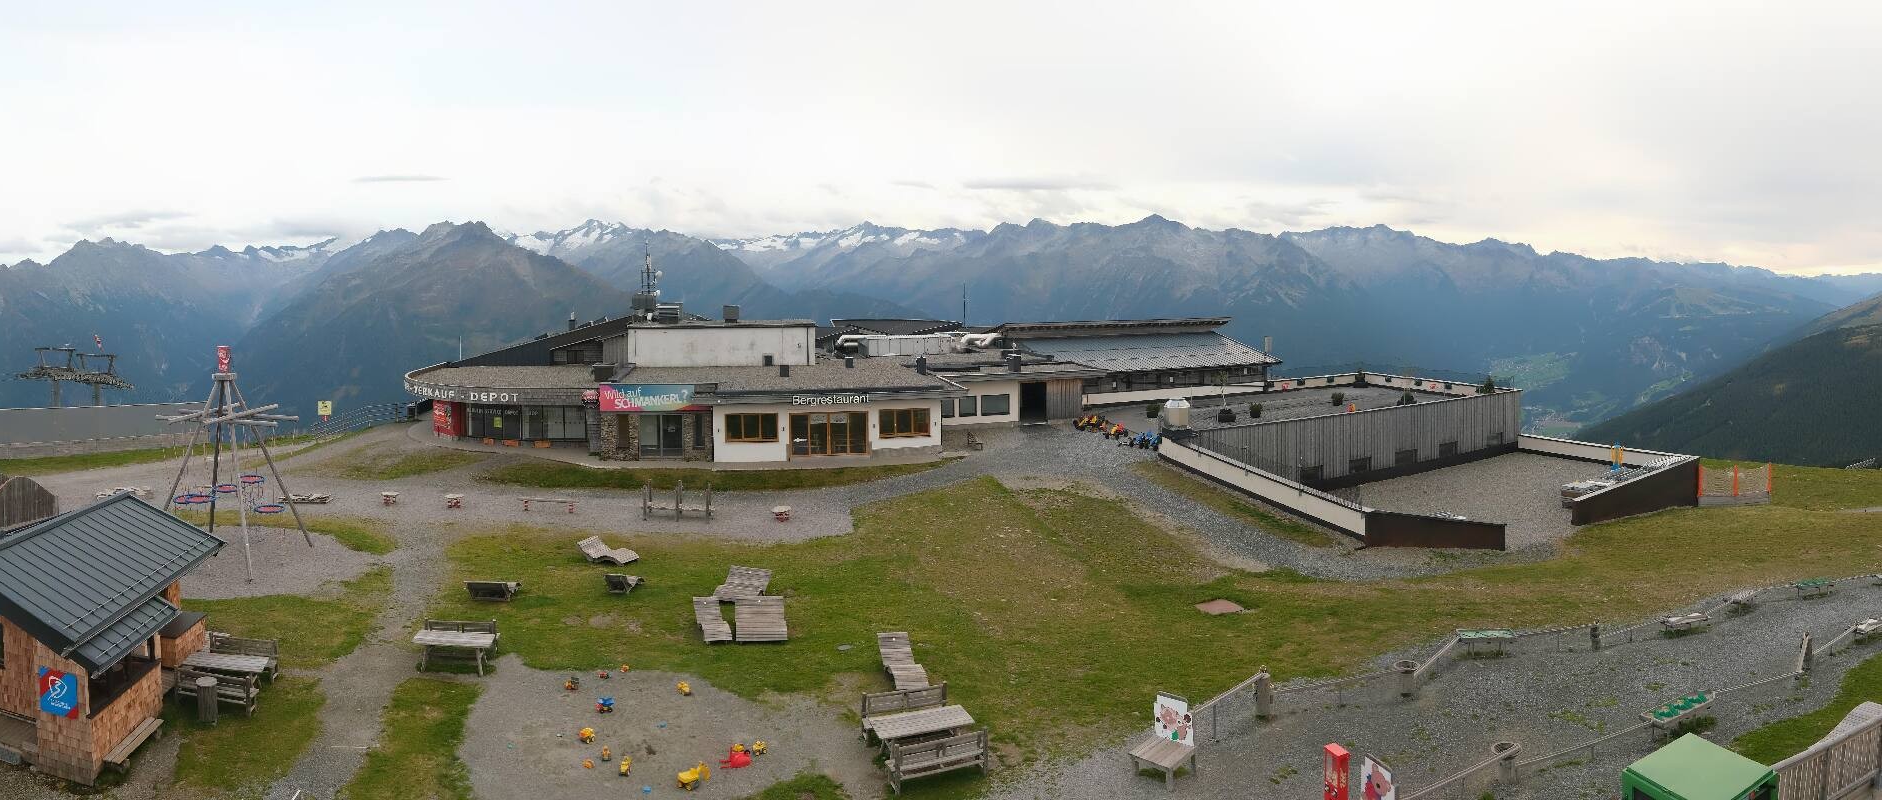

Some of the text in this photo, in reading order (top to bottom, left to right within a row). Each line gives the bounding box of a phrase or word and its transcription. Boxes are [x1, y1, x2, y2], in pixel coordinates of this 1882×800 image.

[470, 392, 519, 402] DEPOT
[604, 388, 625, 400] Wild
[626, 387, 642, 398] auf
[792, 394, 869, 406] Bergrestaurant
